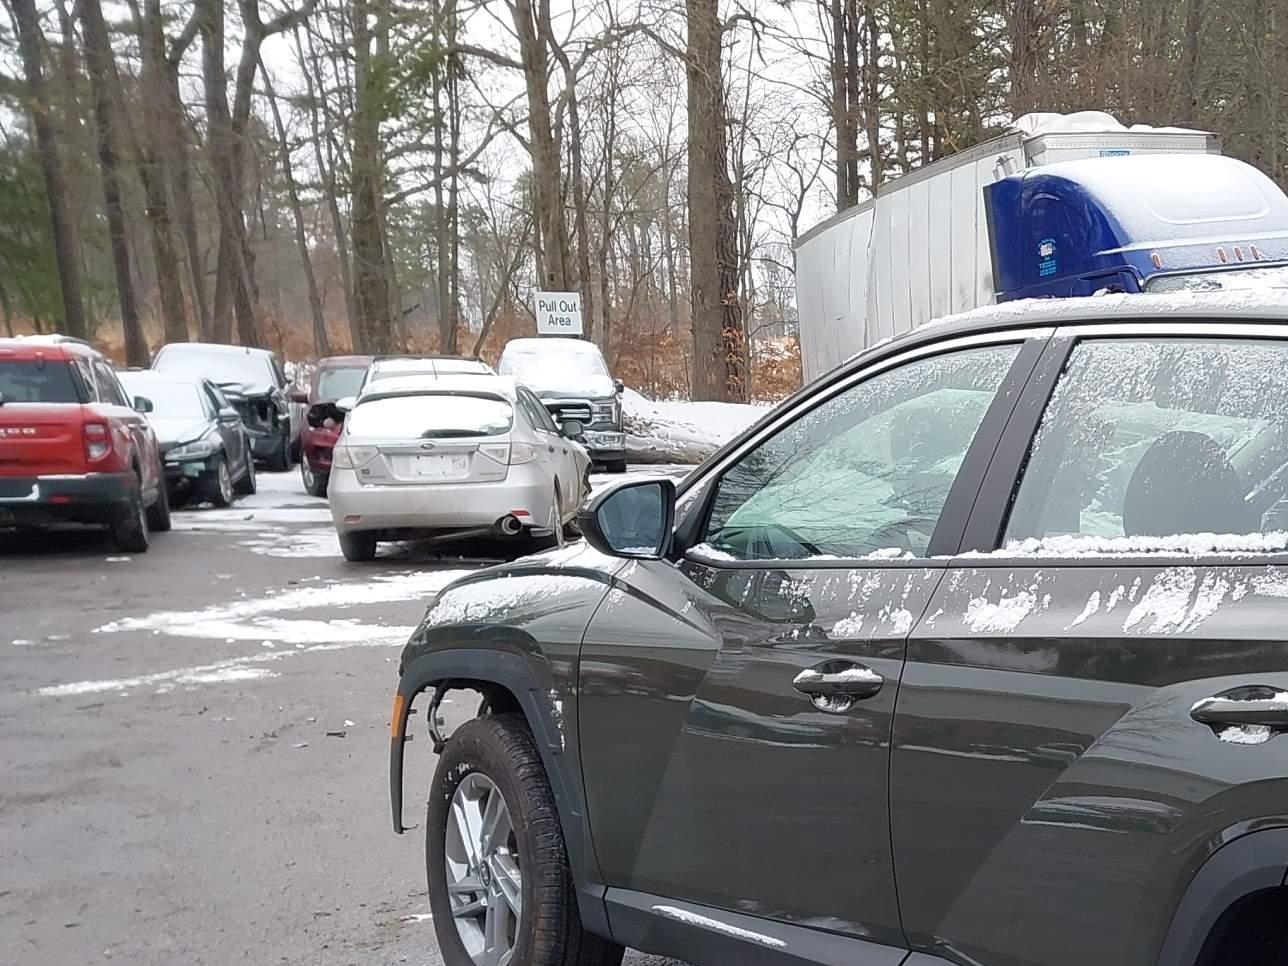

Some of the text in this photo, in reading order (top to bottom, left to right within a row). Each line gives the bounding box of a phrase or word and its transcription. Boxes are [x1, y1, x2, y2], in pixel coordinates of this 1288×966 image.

[539, 300, 577, 313] Pull Out
[548, 314, 571, 326] Area
